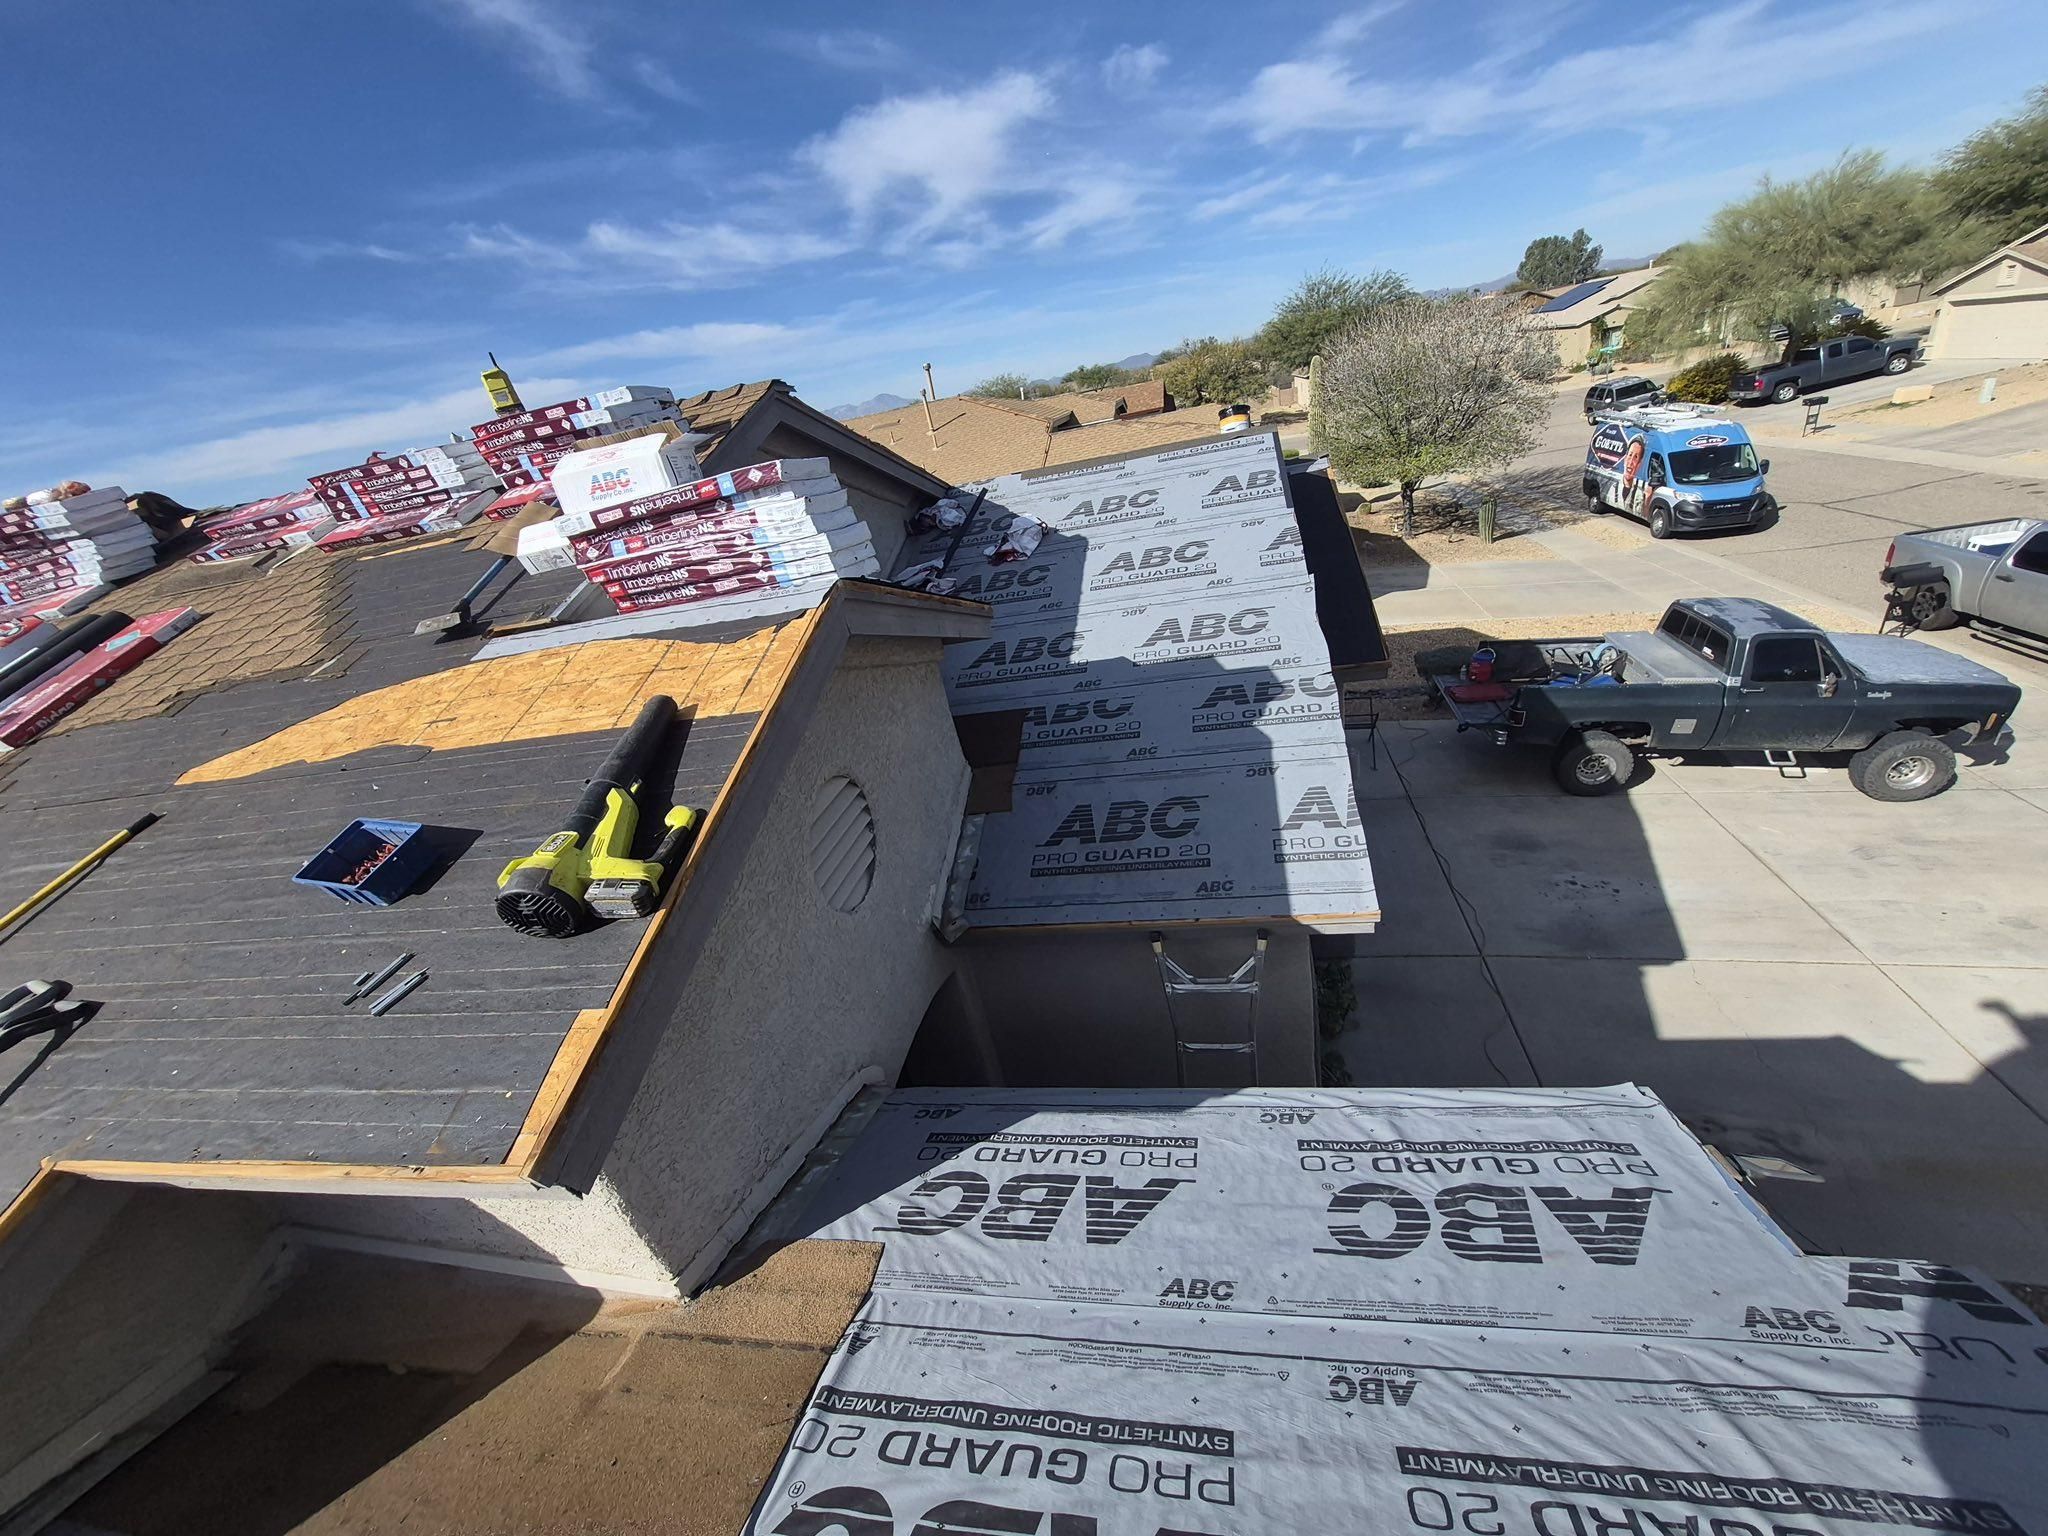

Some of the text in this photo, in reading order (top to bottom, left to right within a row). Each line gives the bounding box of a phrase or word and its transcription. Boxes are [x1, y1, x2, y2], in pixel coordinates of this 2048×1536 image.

[589, 468, 631, 495] ABC
[1057, 487, 1165, 521] ABC
[1202, 495, 1232, 504] PRO
[1088, 511, 1140, 523] GUARD
[1092, 539, 1215, 576] ABC
[1260, 551, 1295, 561] PRO
[960, 563, 1057, 596] ABC
[1090, 562, 1217, 586] PRO GUARD 20
[1207, 577, 1233, 587] ABC
[1122, 607, 1147, 617] ABC
[1134, 606, 1275, 648] ABC
[961, 630, 1092, 670] ABC
[1133, 635, 1281, 660] PRO GUARD 20
[1271, 657, 1302, 667] ABC
[957, 671, 992, 682] PRO
[996, 663, 1059, 677] GUARD
[1073, 679, 1102, 689] ABC
[1193, 673, 1338, 710] ABC
[1192, 711, 1234, 724] PRO
[1242, 703, 1323, 718] GUARD
[1037, 724, 1107, 740] GUARD
[1115, 720, 1141, 732] 20
[1193, 721, 1242, 732] SYNTHETIC
[1243, 718, 1283, 728] ROOFING
[1126, 745, 1159, 756] ABC
[1246, 765, 1280, 777] ABC
[1026, 784, 1057, 796] ABC
[1035, 795, 1209, 847] ABC
[1272, 836, 1325, 850] PRO
[1031, 843, 1211, 866] PRO GUARD 20
[1276, 852, 1335, 863] SYNTHETIC
[1032, 866, 1083, 876] SYNTHETIC
[1127, 859, 1209, 870] UNDERLAYMENT
[1194, 880, 1236, 894] ABC
[915, 1108, 962, 1120] ABC
[1258, 1112, 1317, 1125] ABC
[1046, 1135, 1109, 1145] ROOFING
[1112, 1136, 1196, 1148] SYNTHETIC
[1300, 1140, 1635, 1155] SYNTHETIC ROOFING UNDERLAYMENT
[916, 1147, 1199, 1168] PRO GUARD 20
[1300, 1154, 1660, 1177] PRO GUARD 20
[872, 1171, 1196, 1245] ABC
[1312, 1182, 1674, 1266] ABC
[1156, 1278, 1238, 1301] ABC
[1158, 1299, 1193, 1310] Supply
[1197, 1301, 1212, 1309] Co.
[1740, 1305, 1841, 1334] ABC
[1750, 1330, 1856, 1345] Supply Co. Inc.
[1328, 1364, 1415, 1378] Supply Co. Inc.
[1325, 1375, 1422, 1407] ABC
[817, 1391, 1230, 1450] SYNTHETIC ROOFING UNDERLAYMENT
[792, 1417, 1236, 1506] PRO GUARD 20
[1404, 1455, 2013, 1530] SYNTHETIC ROOFING UNDERLAYMENT
[1406, 1487, 1505, 1536] 20
